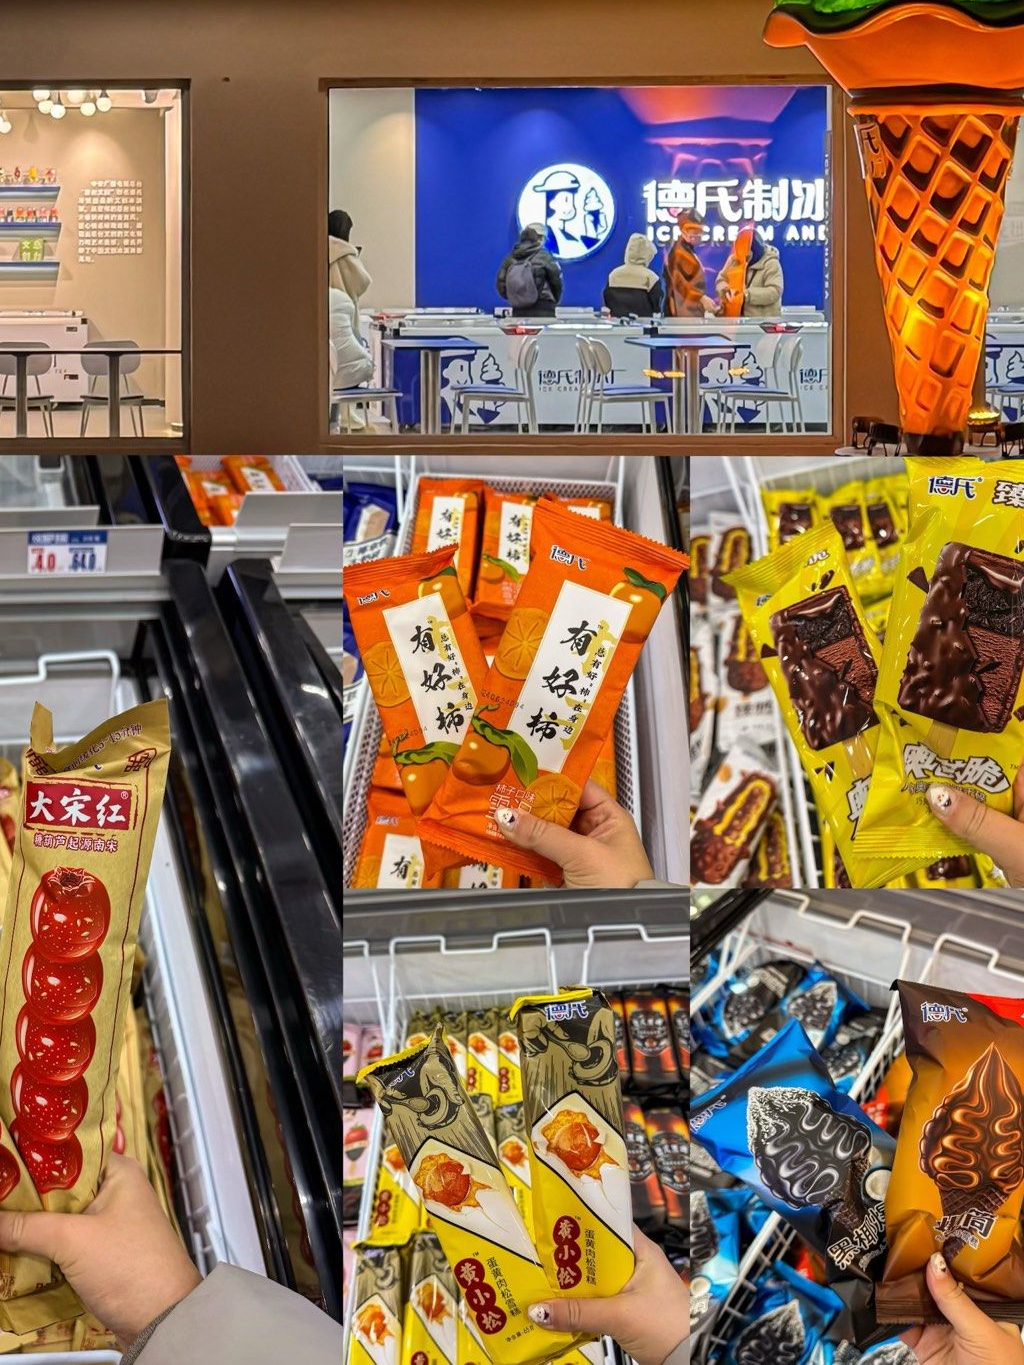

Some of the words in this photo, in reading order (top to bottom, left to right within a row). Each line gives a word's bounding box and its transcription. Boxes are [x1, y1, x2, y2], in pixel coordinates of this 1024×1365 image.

[928, 476, 977, 500] 德氏
[549, 544, 587, 571] 德氏
[410, 625, 465, 734] 有好柿
[526, 620, 597, 743] 有好柿
[29, 788, 126, 827] 大宋红
[495, 783, 536, 803] 柿子口味
[33, 832, 119, 853] 糖葫芦起源南宋
[545, 1002, 588, 1021] 德氏
[922, 1002, 968, 1023] 德氏
[557, 1219, 578, 1286] 黄小松
[585, 1228, 596, 1286] 蛋黄肉松雪糕
[459, 1262, 502, 1331] 黄小松
[486, 1257, 521, 1317] 蛋黄肉松雪糕
